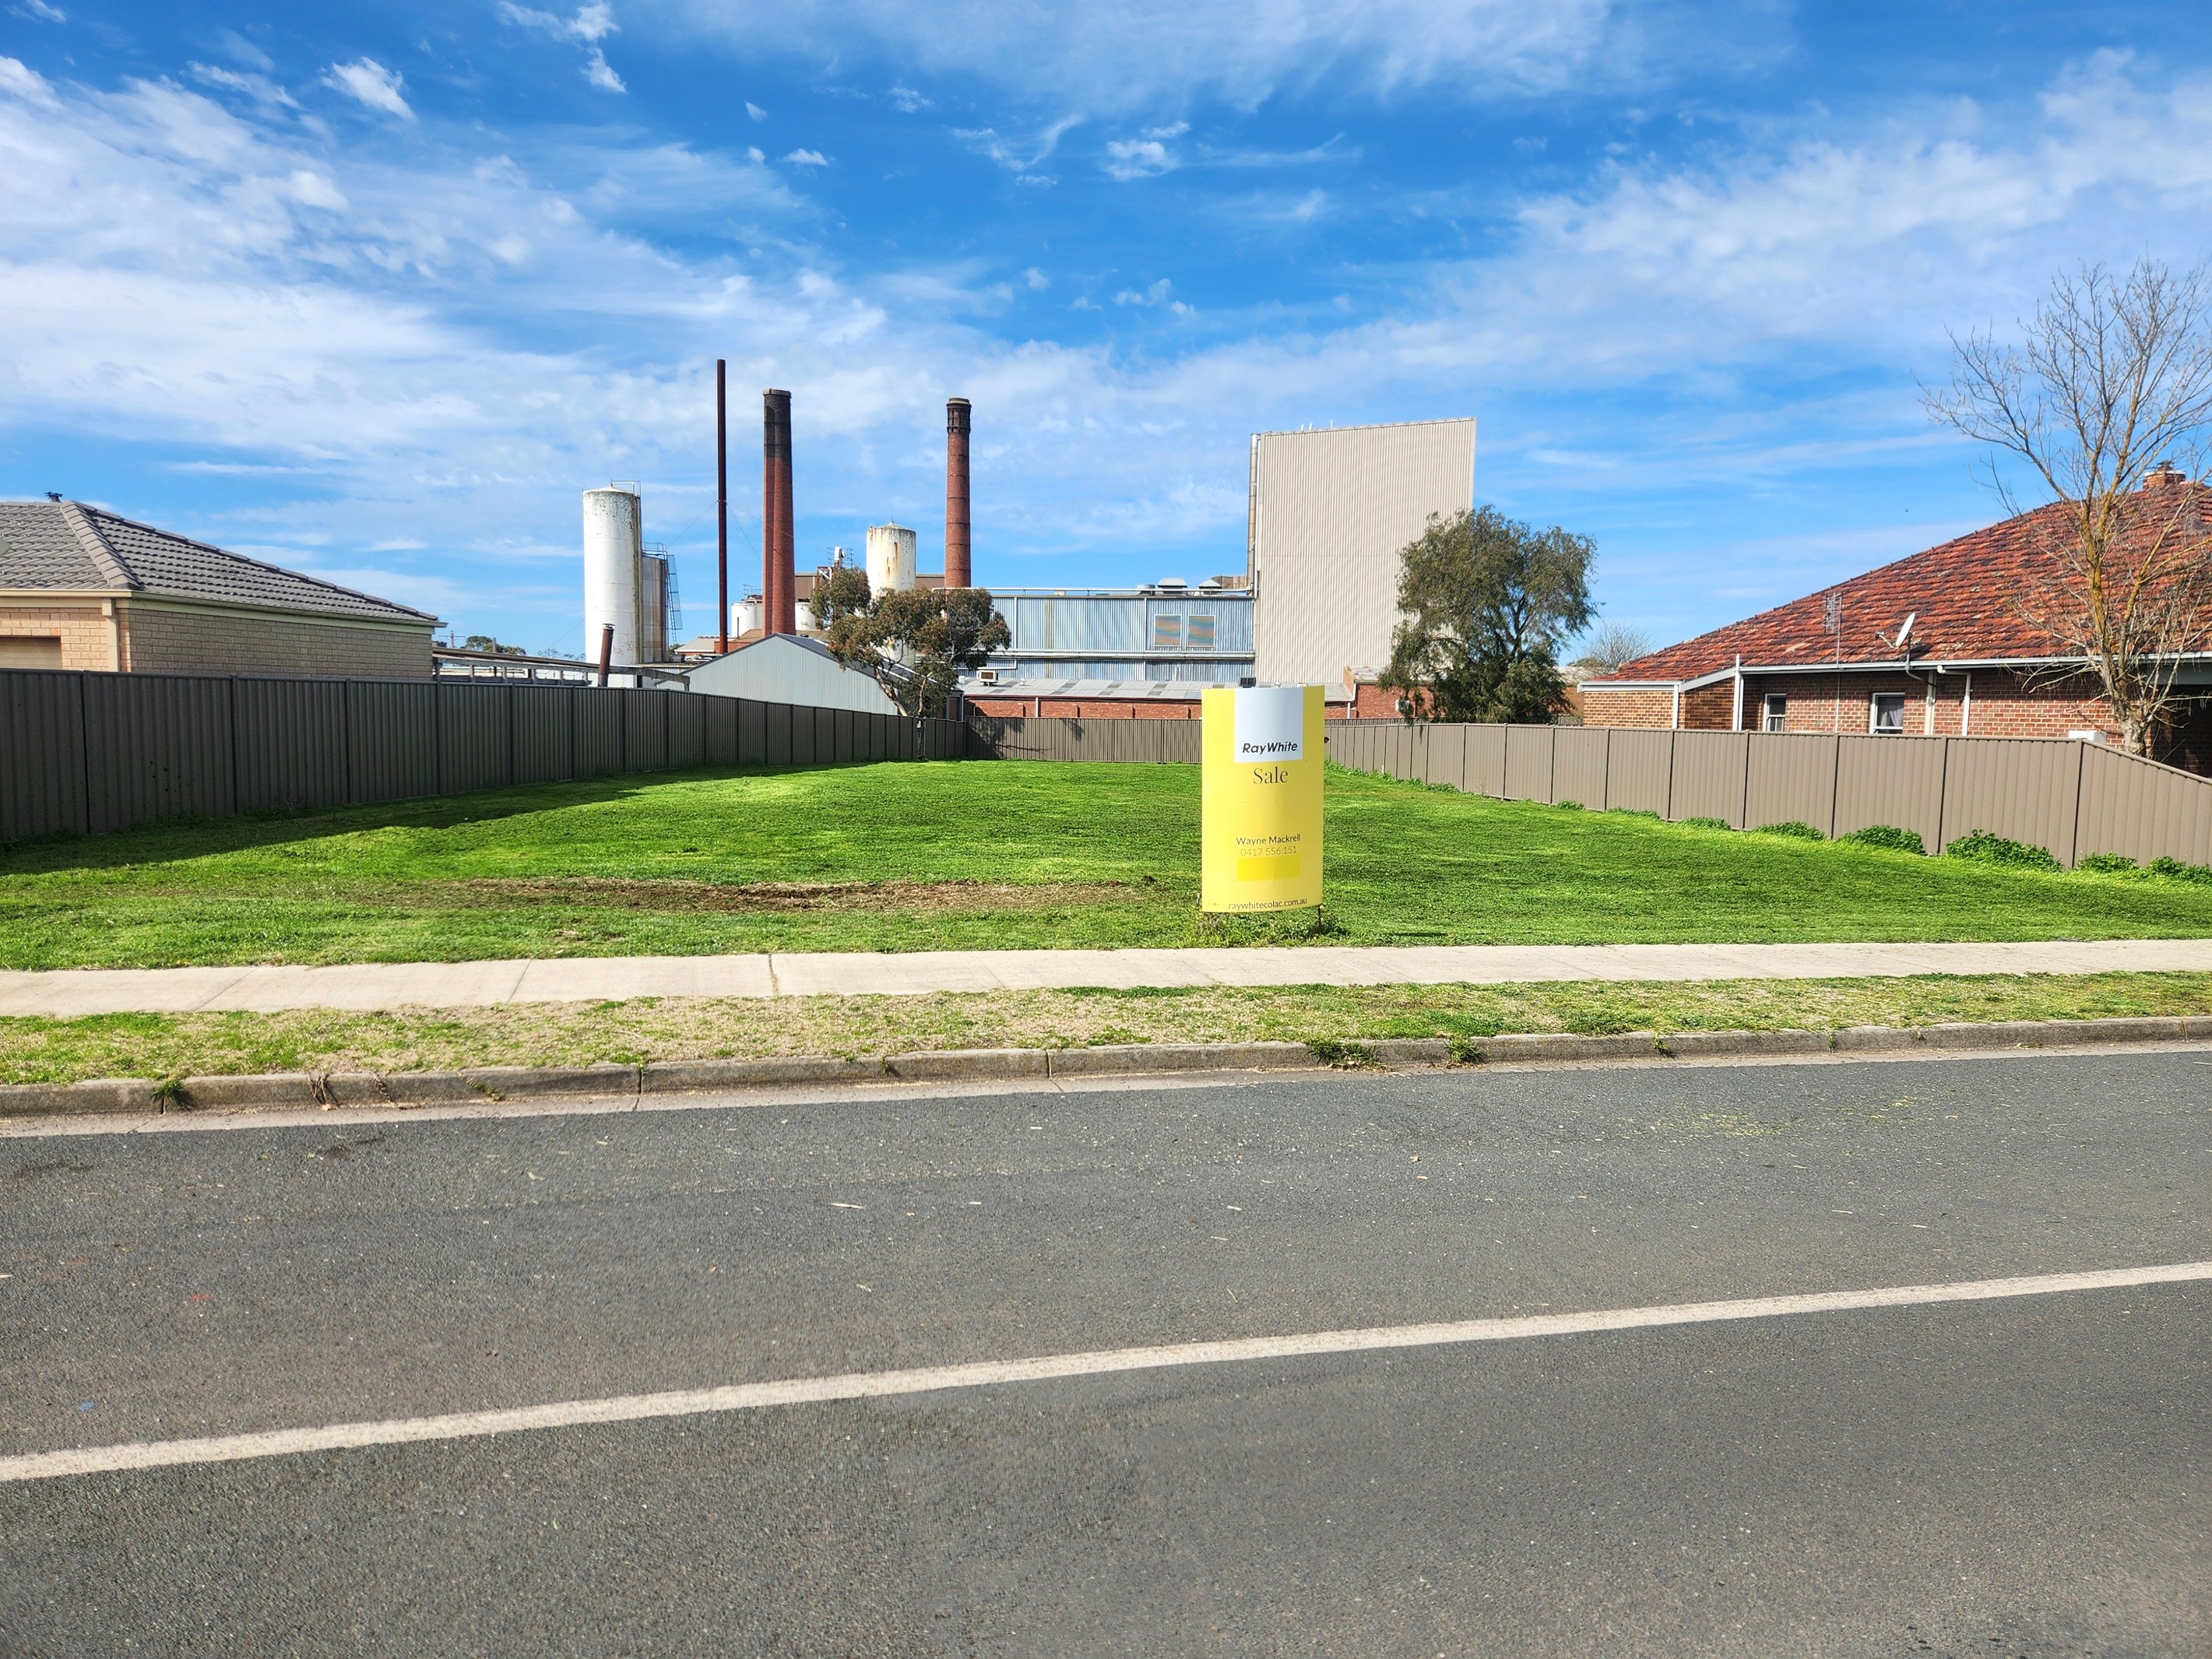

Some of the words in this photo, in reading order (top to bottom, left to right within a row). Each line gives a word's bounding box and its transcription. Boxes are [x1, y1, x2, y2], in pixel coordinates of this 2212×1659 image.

[1253, 766, 1289, 784] Sale
[1236, 837, 1267, 846] Wayne
[1268, 834, 1301, 844] Mackrell
[1240, 848, 1263, 856] 0417
[1265, 847, 1282, 856] 556
[1284, 845, 1297, 854] 151
[1228, 898, 1307, 910] raywhitecolac.com.au
